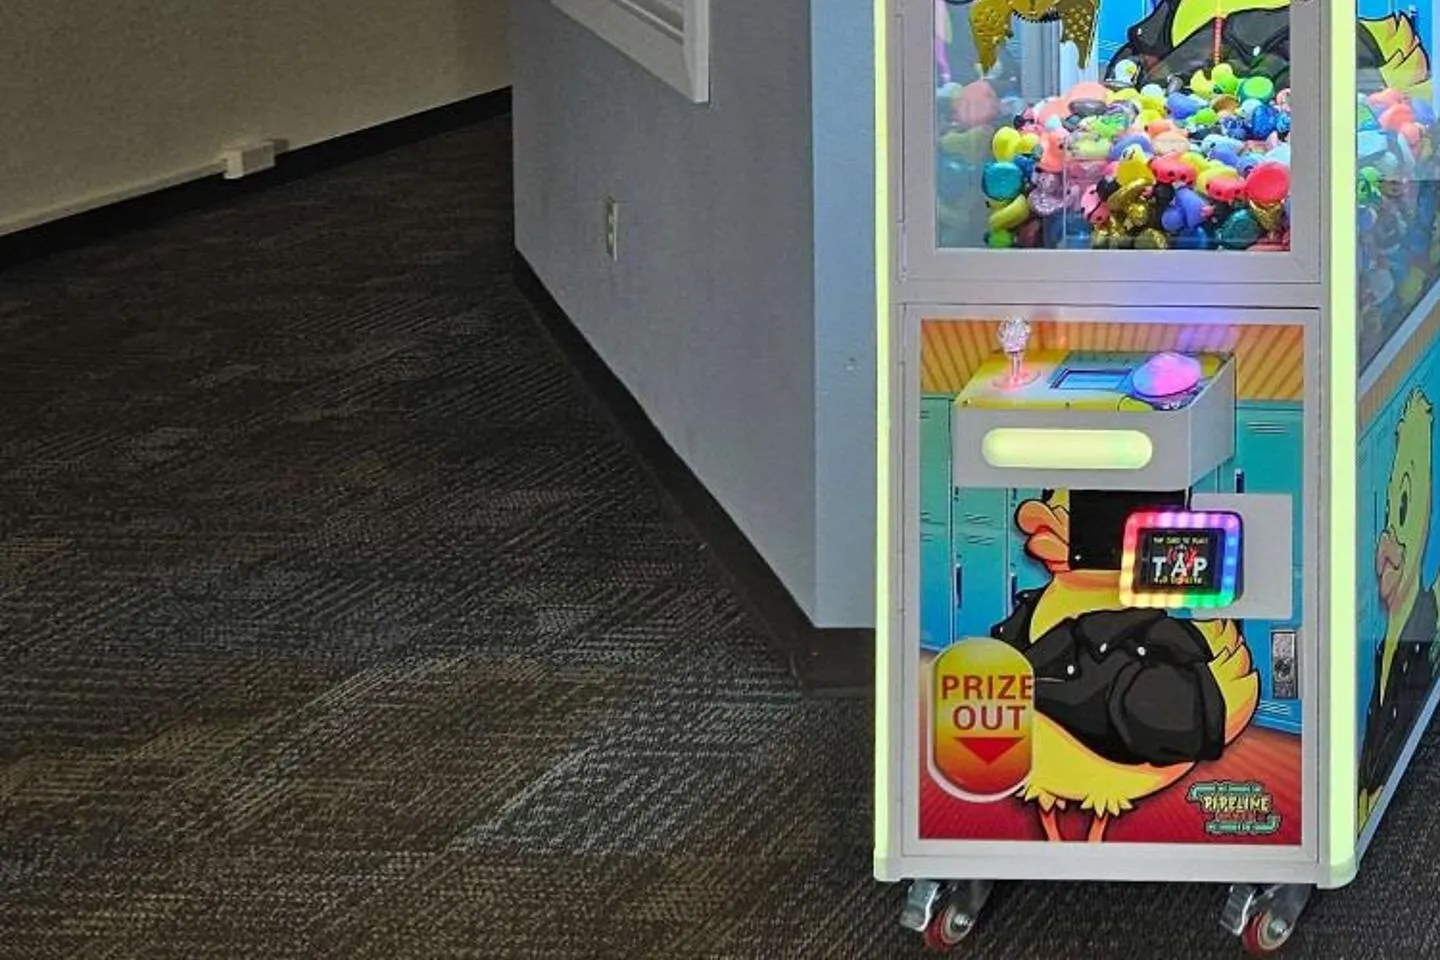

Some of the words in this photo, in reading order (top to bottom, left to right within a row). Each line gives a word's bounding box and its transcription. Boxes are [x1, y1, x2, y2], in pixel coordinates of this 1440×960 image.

[1151, 551, 1208, 578] TAP
[941, 674, 1032, 700] PRIZE
[952, 705, 1026, 731] OUT
